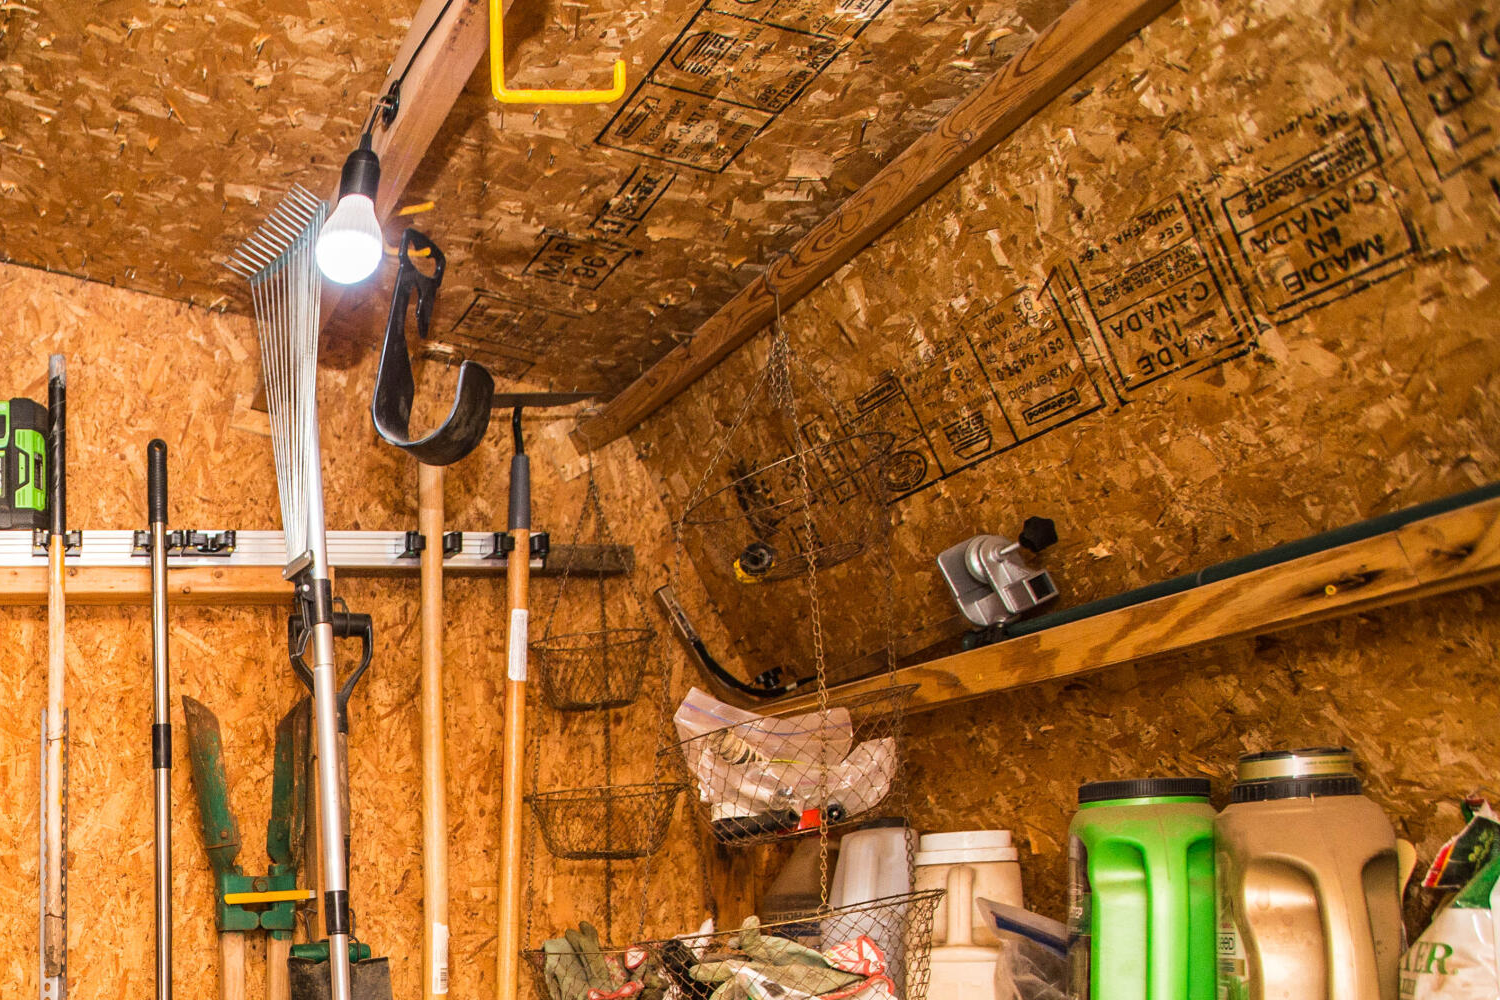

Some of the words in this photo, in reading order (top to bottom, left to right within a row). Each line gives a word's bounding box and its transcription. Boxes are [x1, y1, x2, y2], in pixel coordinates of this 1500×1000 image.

[1246, 177, 1382, 257] CANADA
[535, 242, 582, 278] MAR
[1302, 224, 1345, 260] IN
[571, 255, 608, 279] 96
[1279, 231, 1388, 299] MADE
[1106, 278, 1213, 342] CANADA
[1148, 317, 1183, 347] IN
[1134, 324, 1218, 377] MADE
